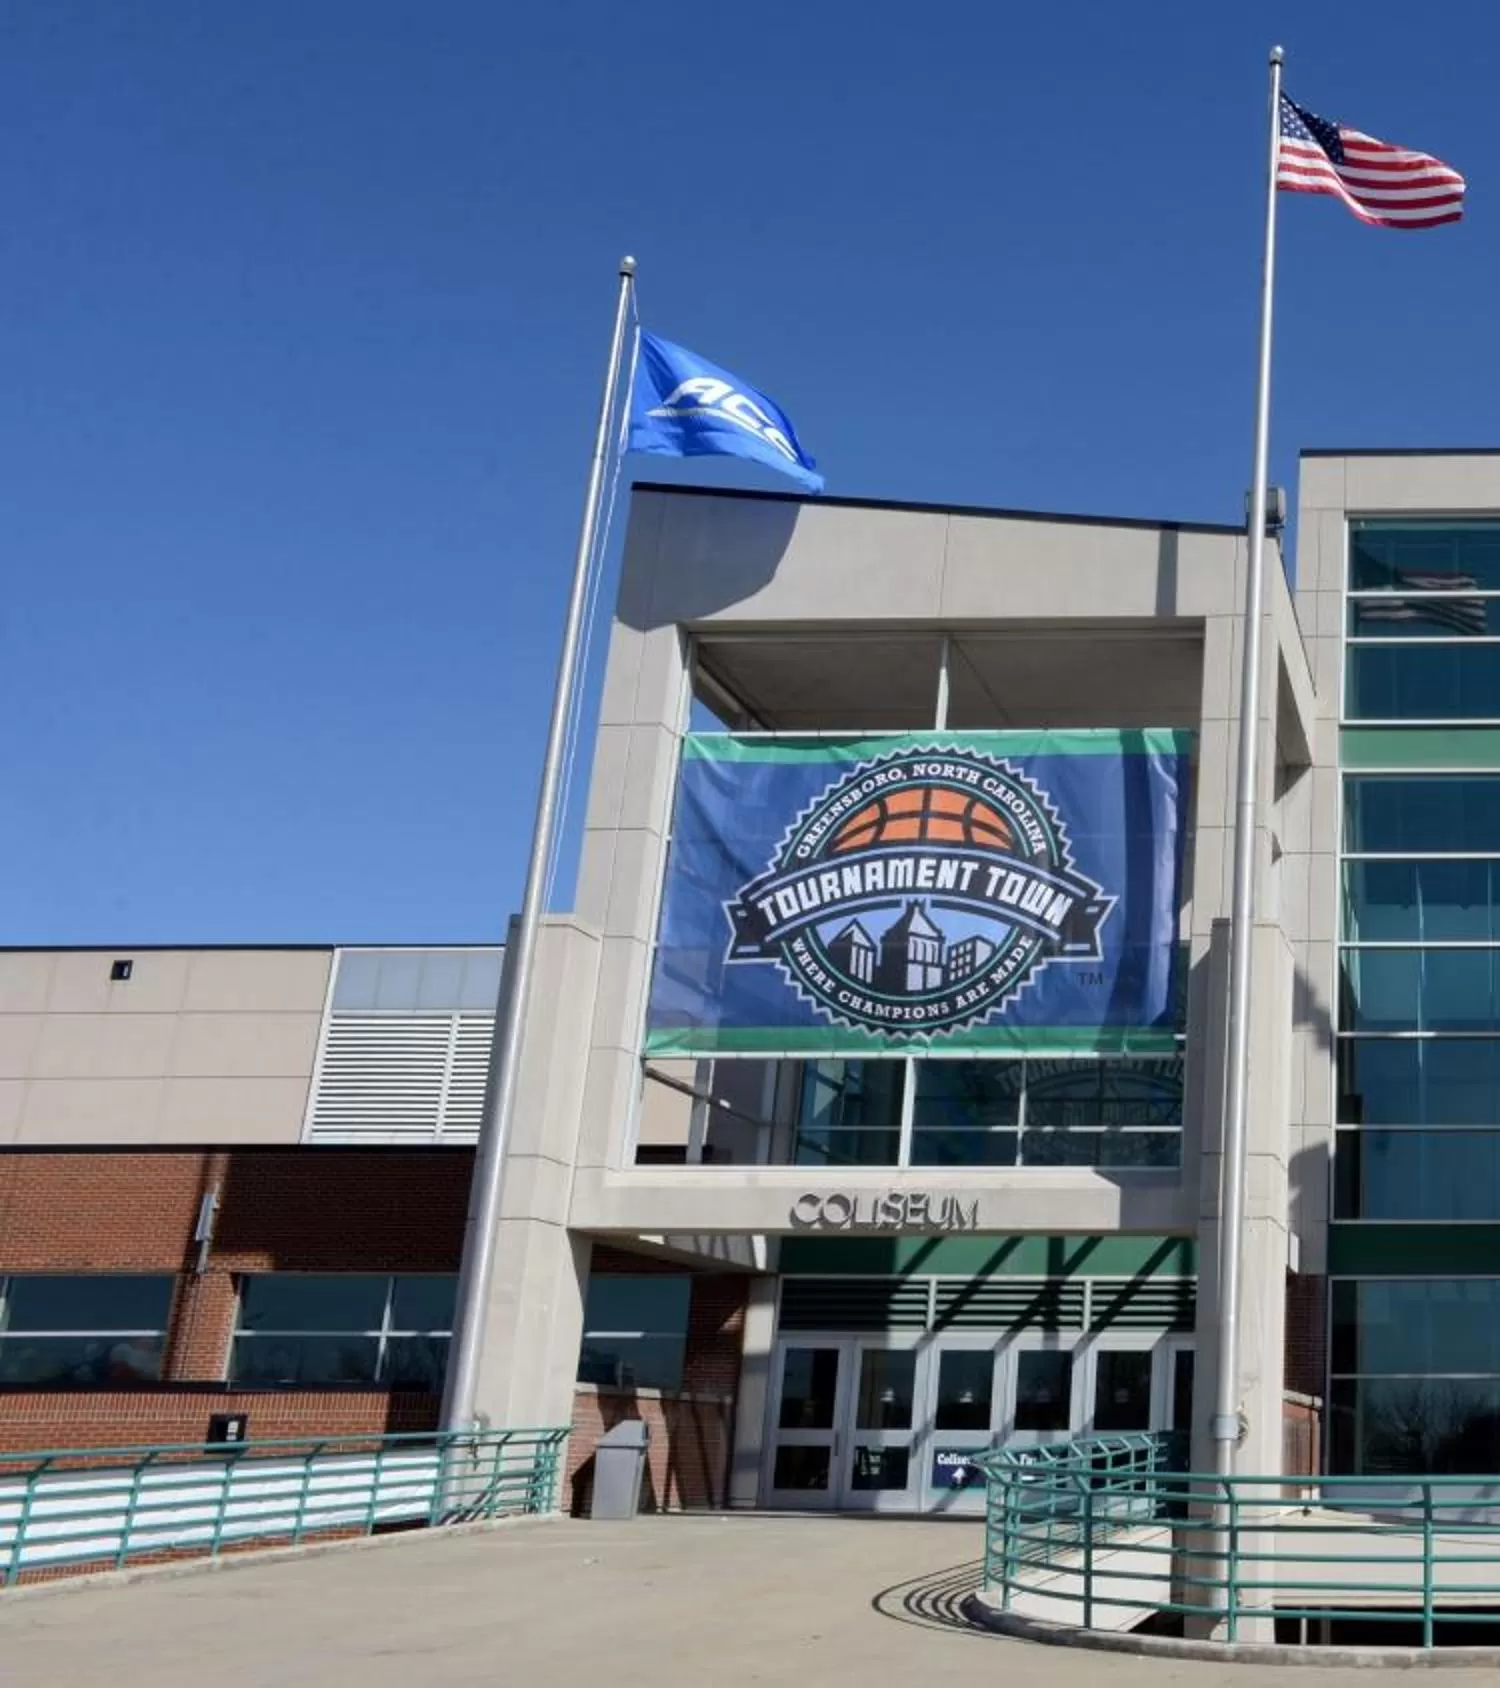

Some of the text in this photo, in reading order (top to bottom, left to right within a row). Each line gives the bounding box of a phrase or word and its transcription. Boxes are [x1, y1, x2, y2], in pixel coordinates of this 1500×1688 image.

[796, 763, 1048, 859] GREENSBORO, NORTH CAROLINA
[757, 857, 1074, 928] TOURNAMENT TOWN
[790, 935, 1034, 1019] WHERE CHAMPIONS ARE MADE
[1078, 972, 1104, 986] TM
[790, 1193, 979, 1229] COLISEUM
